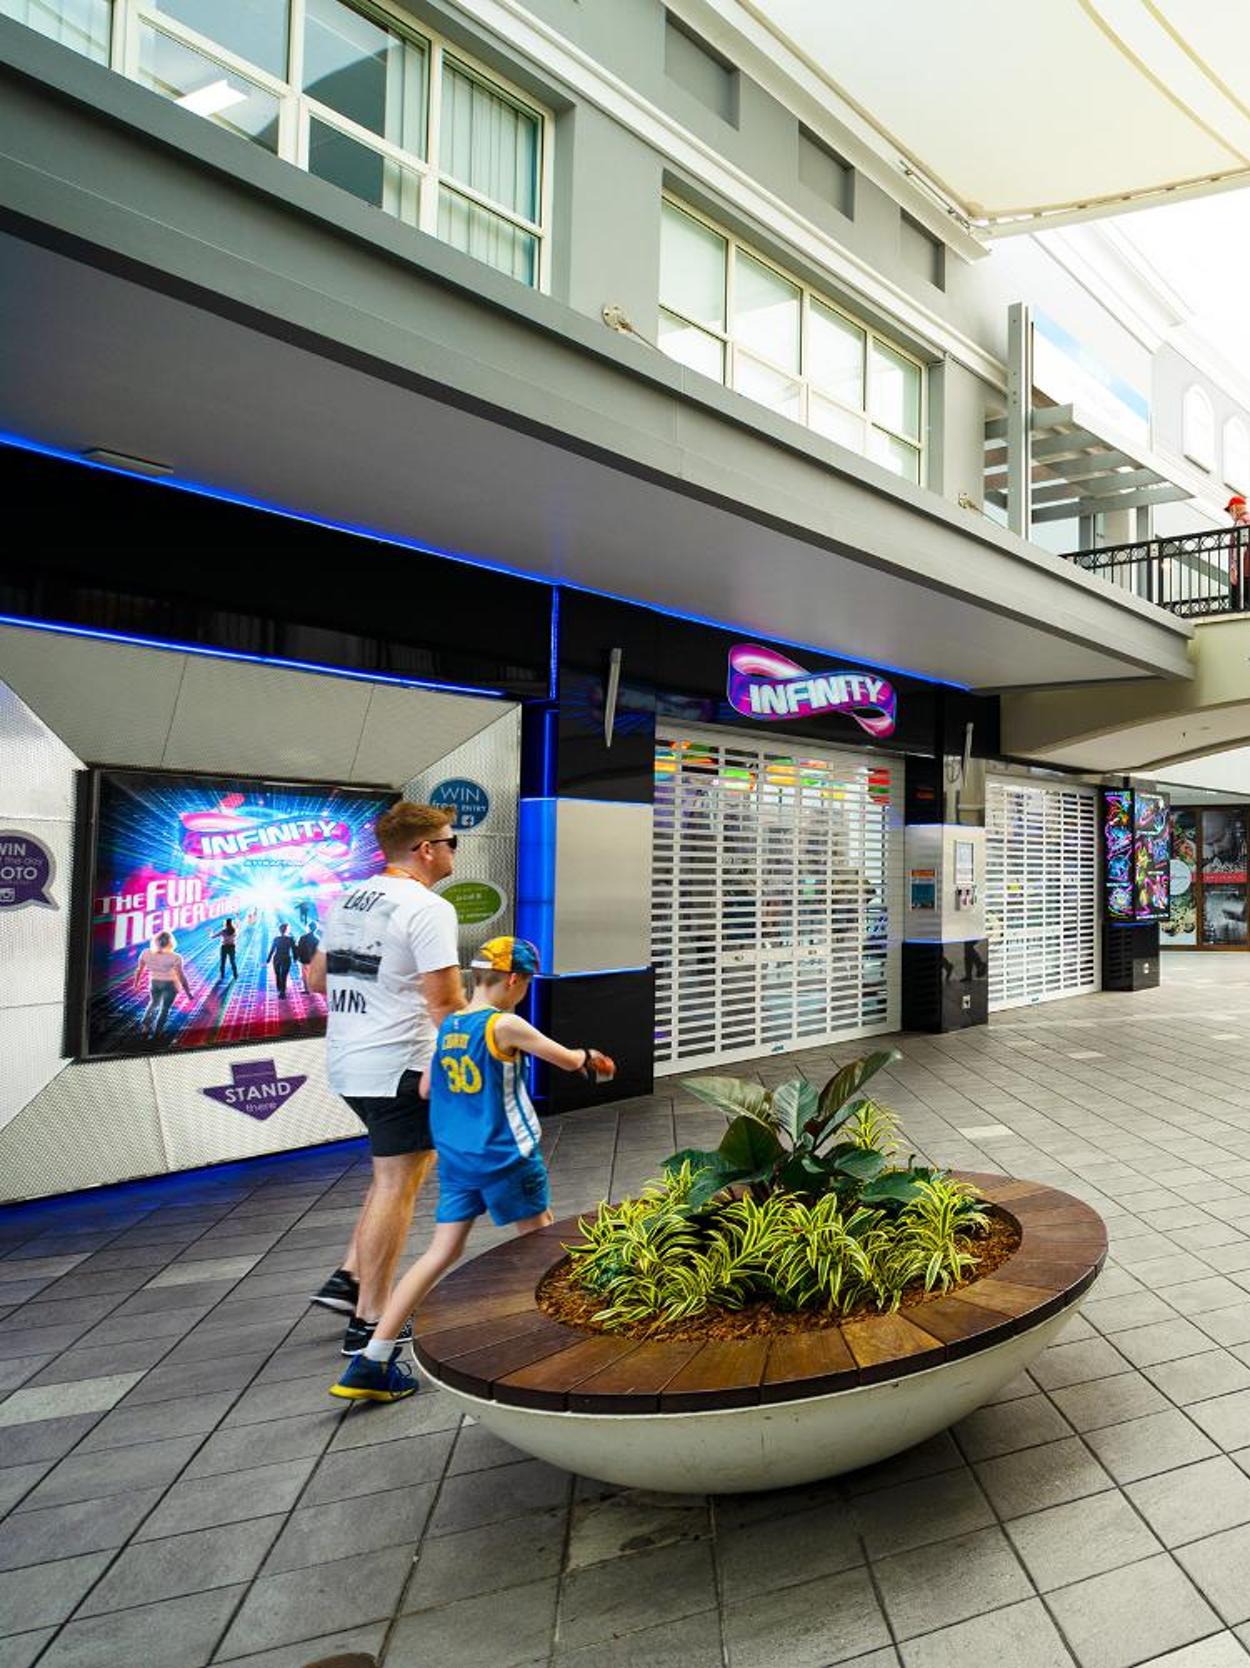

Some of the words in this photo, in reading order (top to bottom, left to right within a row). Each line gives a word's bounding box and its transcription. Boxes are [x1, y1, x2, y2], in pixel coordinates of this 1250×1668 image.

[749, 674, 884, 715] INFINITY
[441, 786, 481, 801] WIN
[200, 821, 338, 856] INFINITY
[0, 866, 38, 880] OTO
[98, 892, 145, 914] THE
[146, 879, 202, 912] FUN
[343, 888, 386, 912] LAST
[114, 902, 208, 951] NEVER
[441, 1055, 483, 1094] 30
[225, 1081, 291, 1104] STAND
